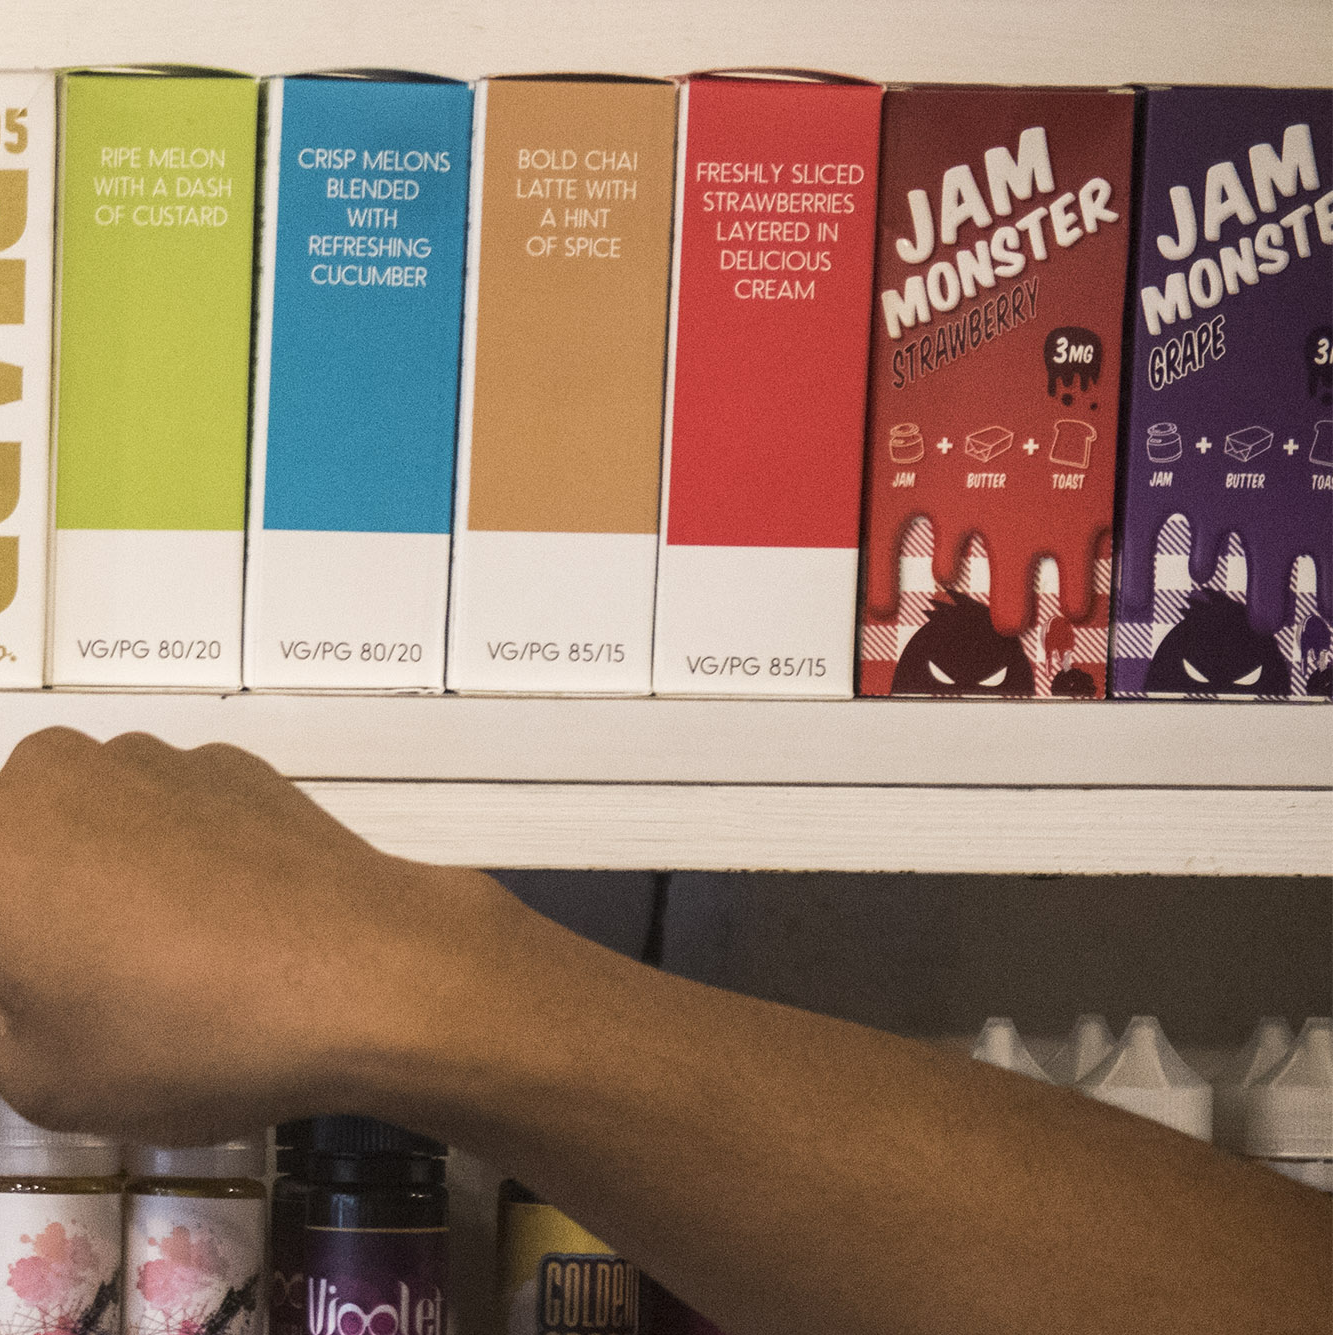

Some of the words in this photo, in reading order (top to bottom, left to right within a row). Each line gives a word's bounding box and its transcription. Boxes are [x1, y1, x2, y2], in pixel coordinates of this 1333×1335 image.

[100, 147, 142, 169] RIPE
[148, 147, 226, 169] MELON
[298, 149, 357, 170] CRISP
[363, 151, 451, 172] MELONS
[518, 149, 578, 170] BOLD
[585, 150, 639, 171] CHAI
[696, 162, 784, 184] FRESHLY
[792, 163, 864, 185] SLICED
[94, 176, 144, 199] WITH
[151, 177, 170, 198] A
[176, 177, 233, 199] DASH
[326, 179, 419, 200] BLENDED
[516, 178, 579, 199] LATTE
[585, 179, 637, 200] WITH
[894, 126, 1057, 266] JAM
[1156, 123, 1322, 263] JAM
[703, 191, 855, 214] STRAWBERRIES
[95, 206, 127, 227] OF
[133, 206, 228, 228] CUSTARD
[346, 208, 398, 228] WITH
[540, 208, 557, 228] A
[563, 208, 611, 229] HINT
[716, 221, 810, 242] LAYERED
[818, 222, 838, 243] IN
[308, 236, 432, 259] REFRESHING
[526, 237, 559, 257] OF
[564, 237, 622, 259] SPICE
[880, 176, 1120, 340] MONSTER
[720, 250, 832, 272] DELICIOUS
[310, 264, 428, 288] CUCUMBER
[734, 279, 816, 301] CREAM
[891, 276, 1041, 391] STRAWBERRY
[1052, 338, 1094, 365] 3MG
[1148, 314, 1228, 392] GRAPE
[892, 472, 916, 488] JAM
[966, 472, 1008, 490] BUTTER
[1052, 473, 1086, 490] TOAST
[1149, 471, 1174, 488] JAM
[1225, 472, 1266, 490] BUTTER
[78, 639, 150, 660] VG/PG
[158, 640, 221, 660] 80/20
[280, 640, 353, 662] VG/PG
[360, 642, 423, 664] 80/20
[487, 641, 560, 663] VG/PG
[568, 642, 626, 664] 85/15
[686, 655, 761, 676] VG/PG
[769, 656, 827, 678] 85/15
